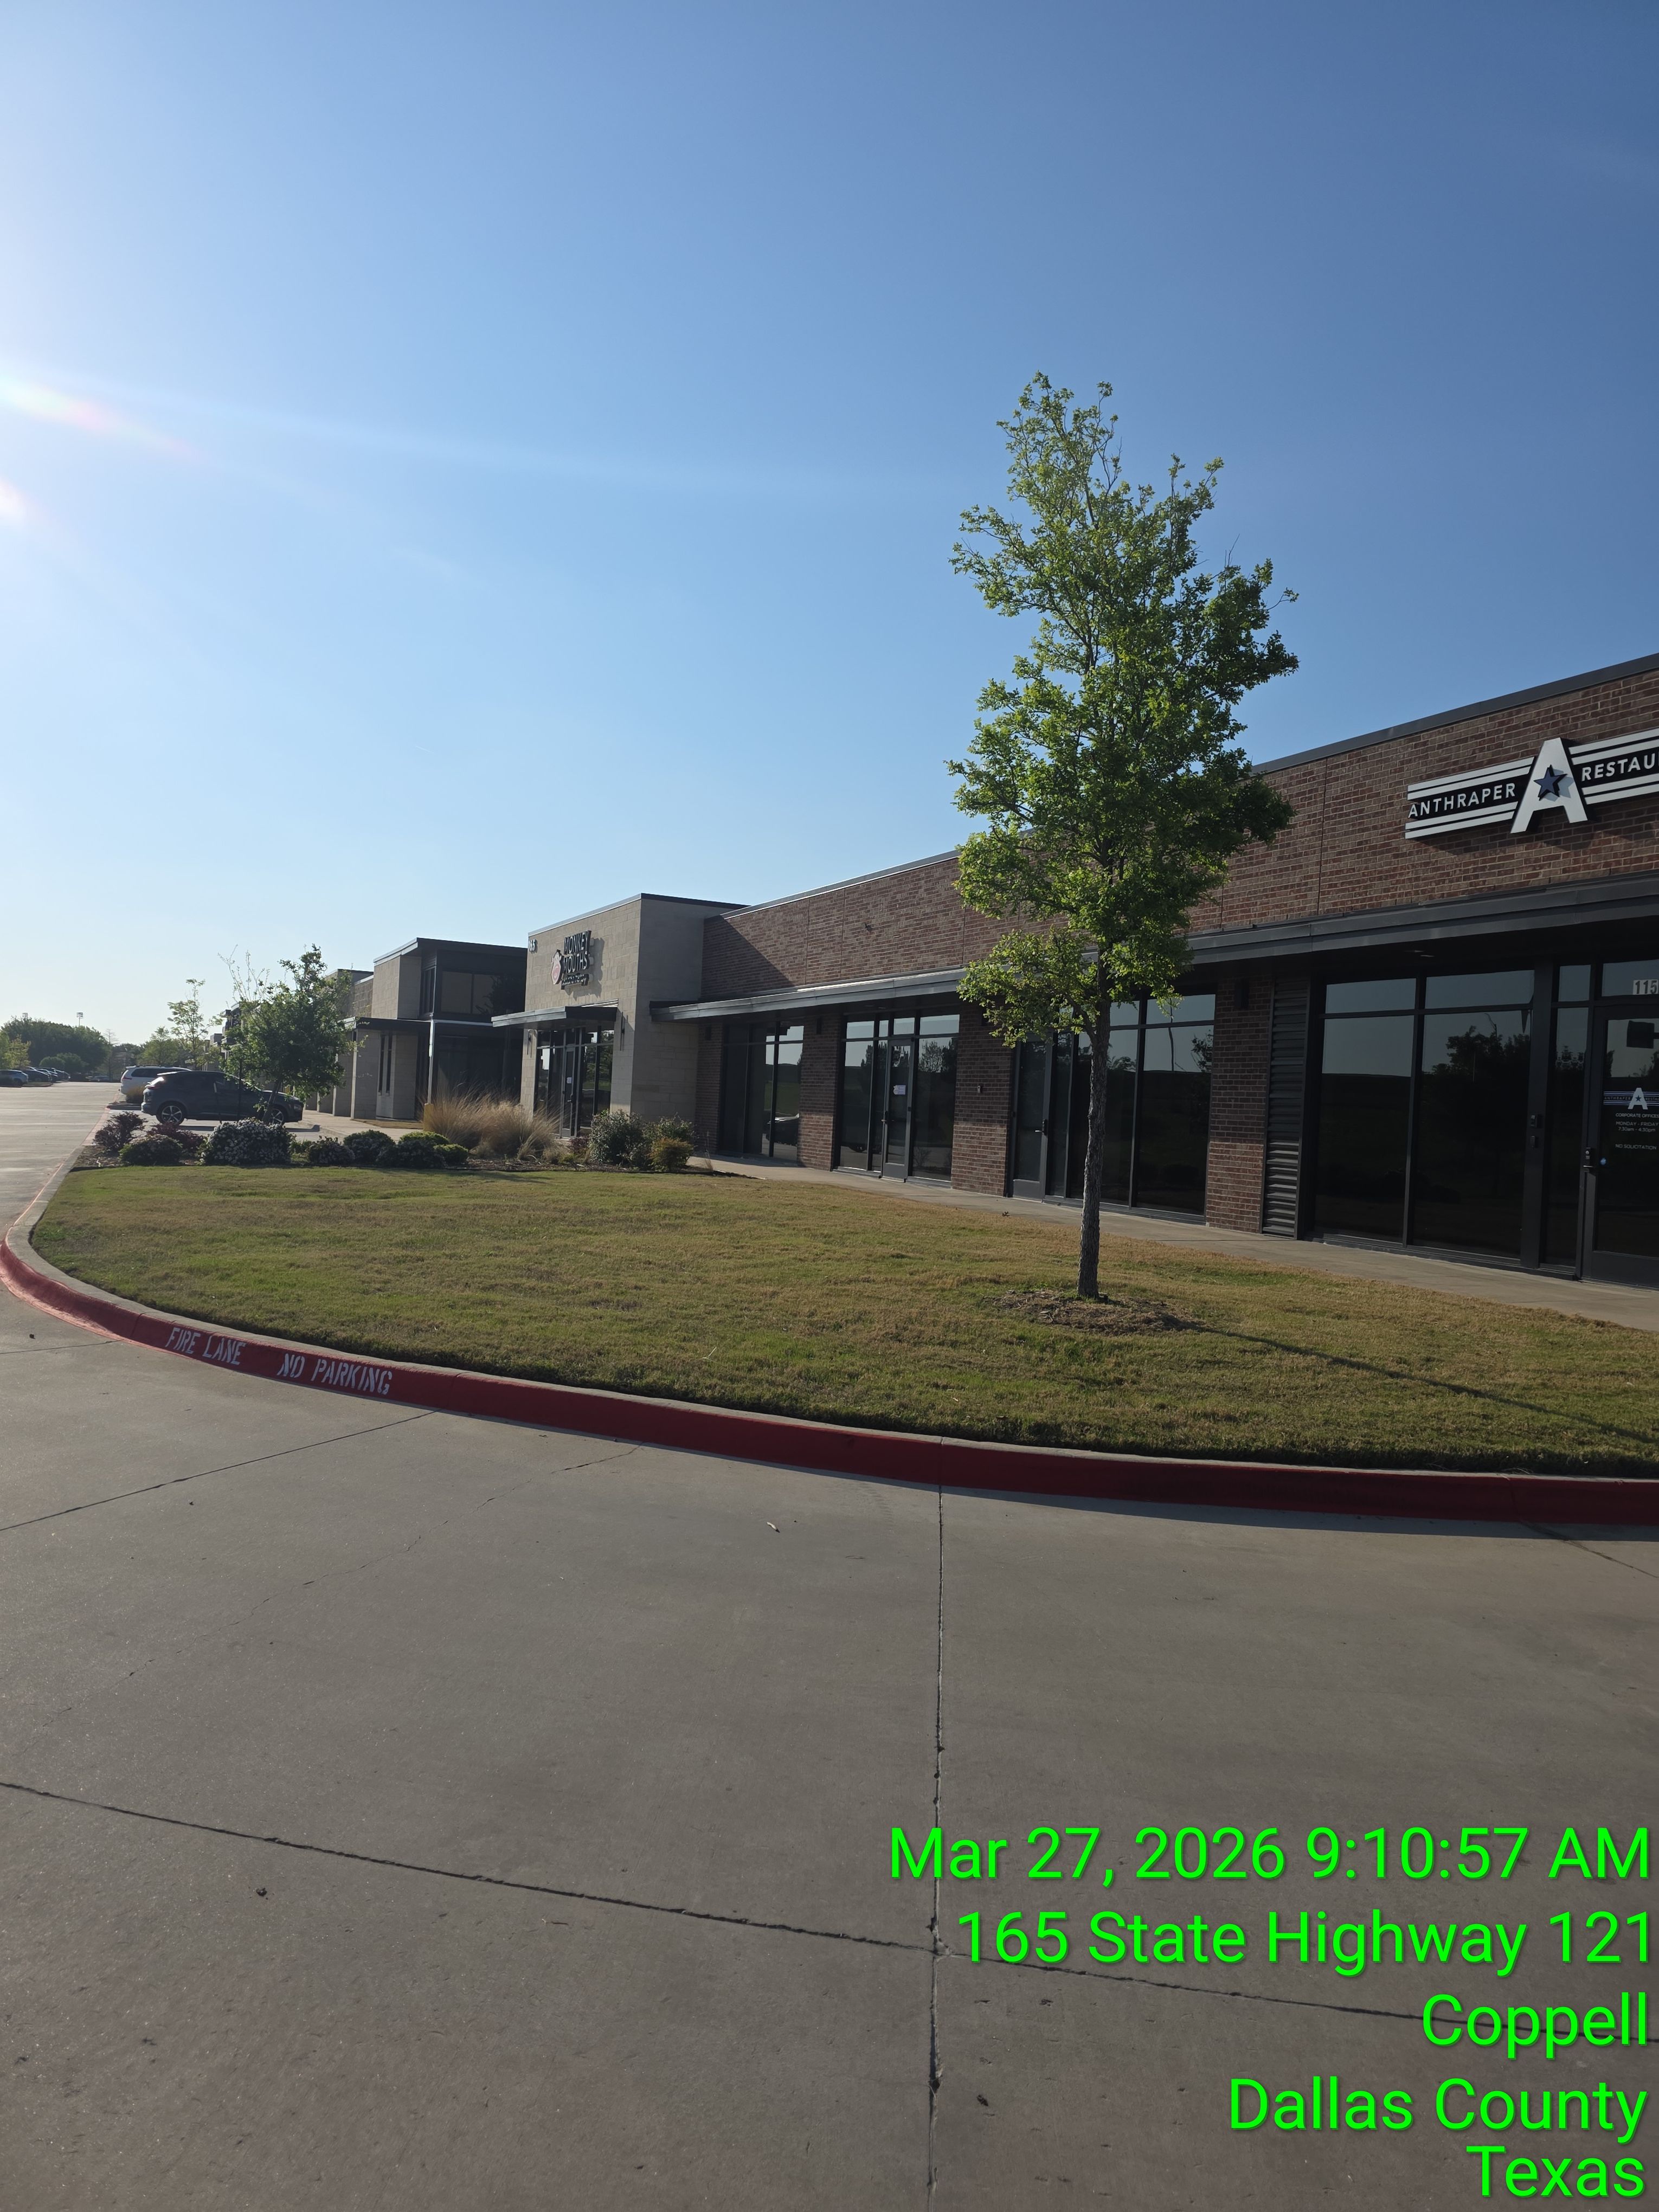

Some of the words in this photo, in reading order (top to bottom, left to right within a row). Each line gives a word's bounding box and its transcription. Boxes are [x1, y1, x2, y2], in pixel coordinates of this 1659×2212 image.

[1407, 783, 1516, 819] ANTHRAPER
[1510, 737, 1589, 833] A
[1581, 751, 1659, 781] RESTAU
[564, 931, 589, 954] MONKEY
[563, 951, 588, 973] MOUTHS
[1635, 980, 1657, 994] 115
[1628, 1087, 1648, 1110] A
[165, 1327, 201, 1354] FIRE
[202, 1335, 248, 1366] LANE
[276, 1353, 306, 1379] NO
[311, 1359, 393, 1396] PARKING
